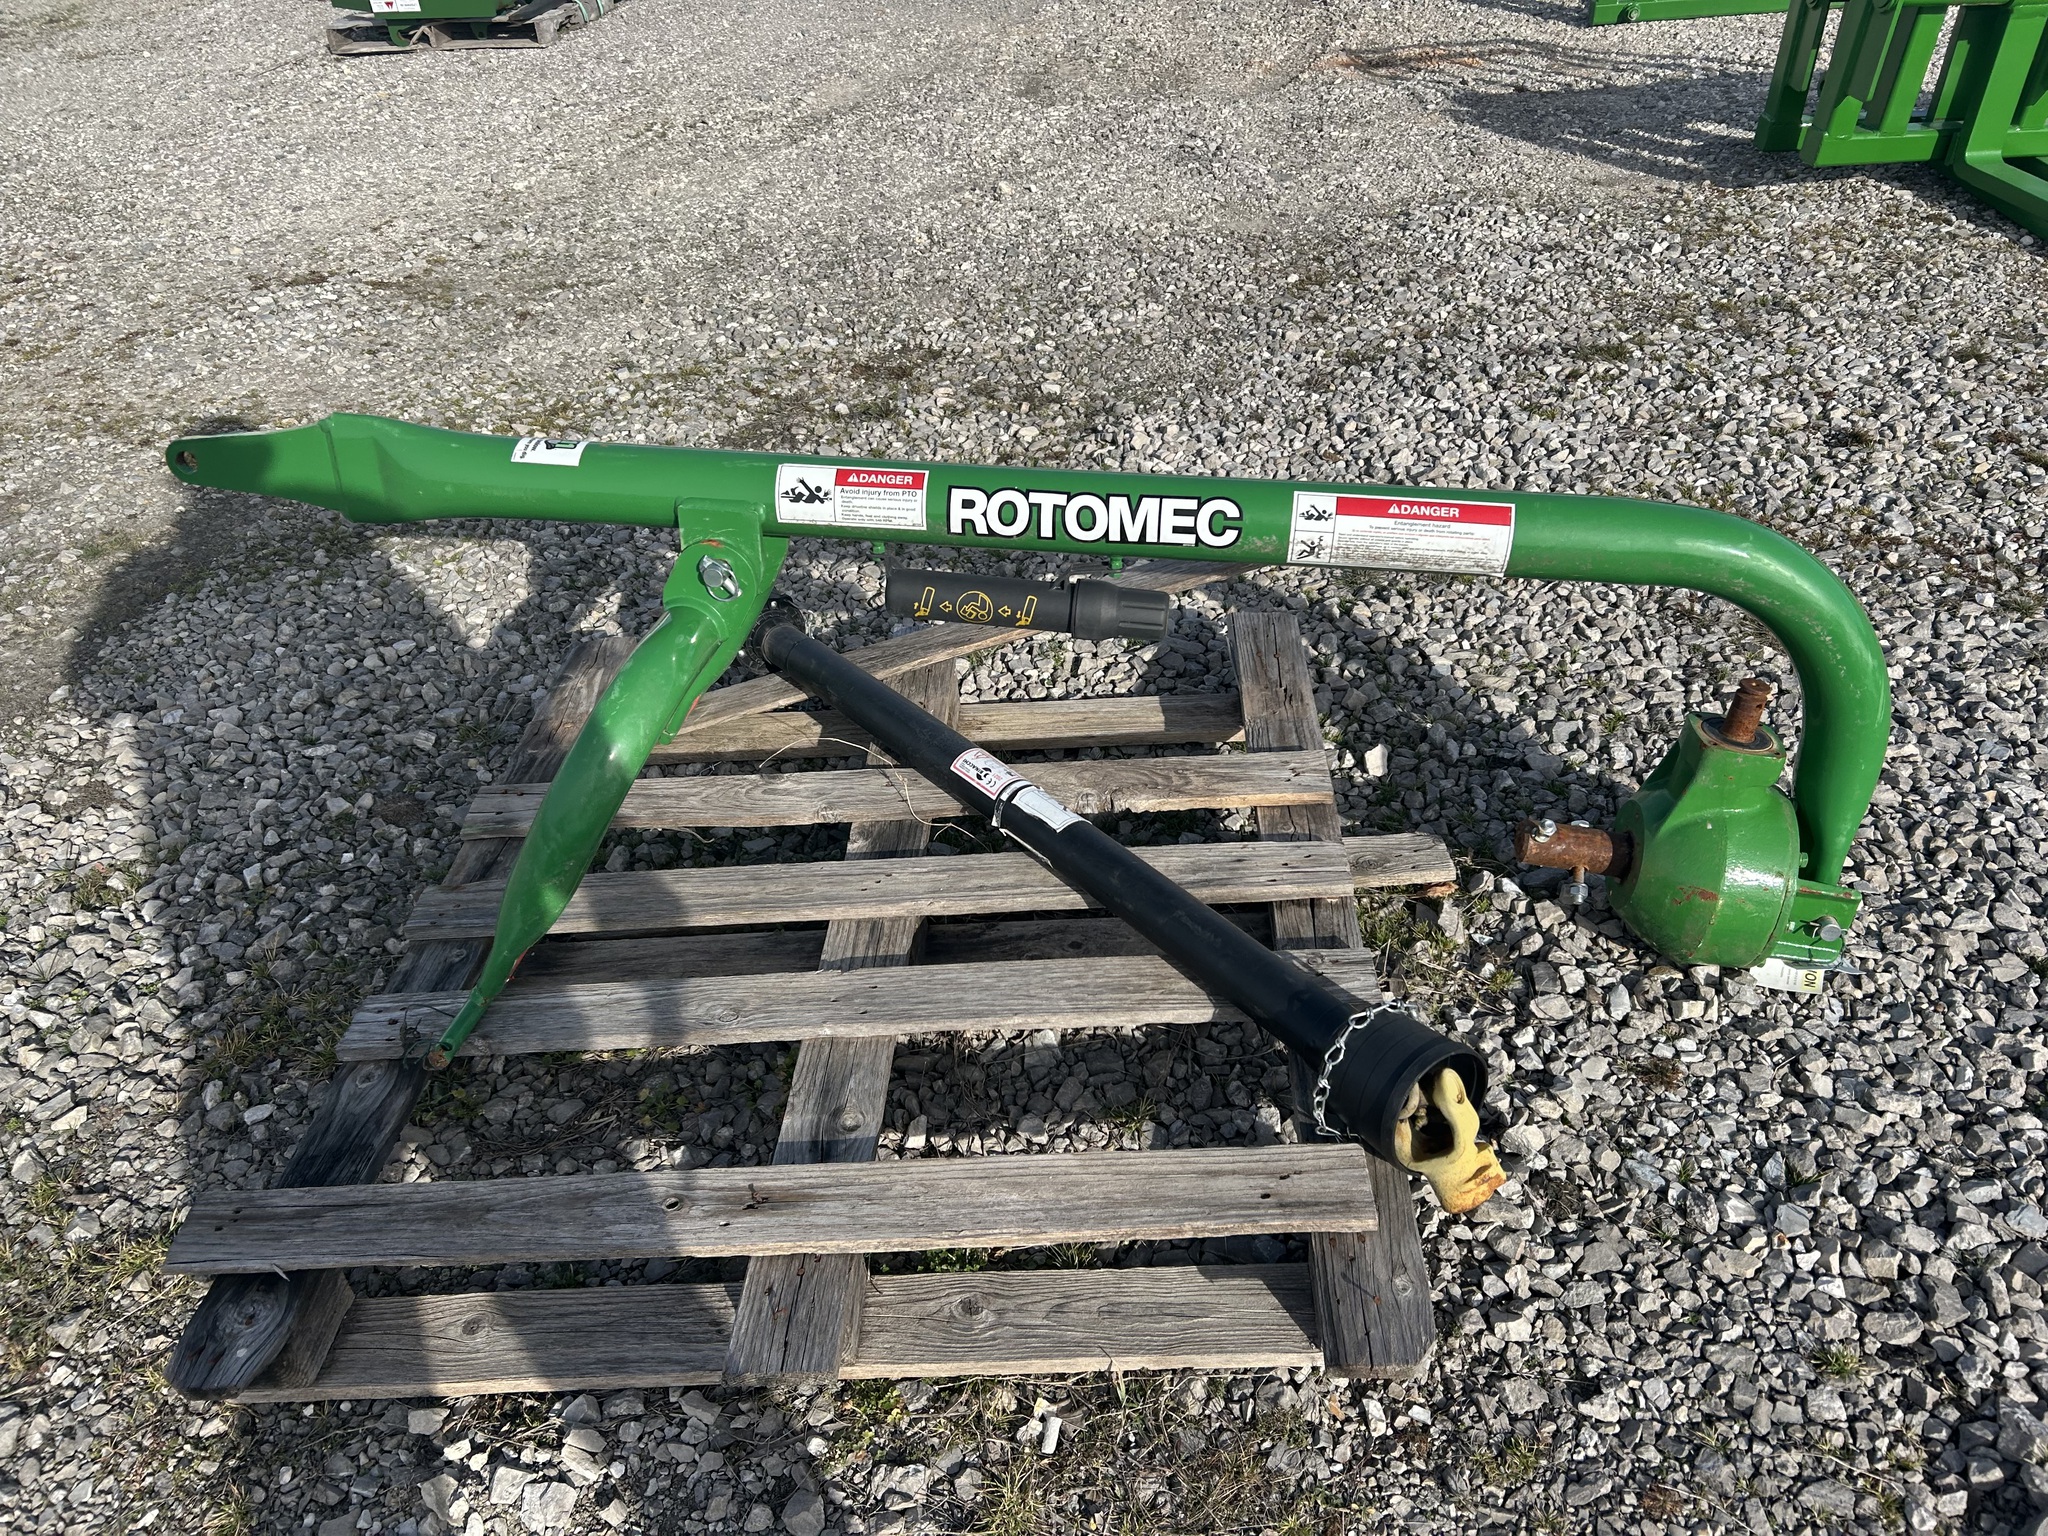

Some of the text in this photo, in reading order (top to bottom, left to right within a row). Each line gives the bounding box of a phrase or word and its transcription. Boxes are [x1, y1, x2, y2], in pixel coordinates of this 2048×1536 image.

[860, 473, 913, 485] DANGER
[840, 487, 860, 495] Avoid
[862, 489, 881, 497] injury
[948, 485, 1243, 548] ROTOMEC
[1400, 504, 1459, 518] DANGER
